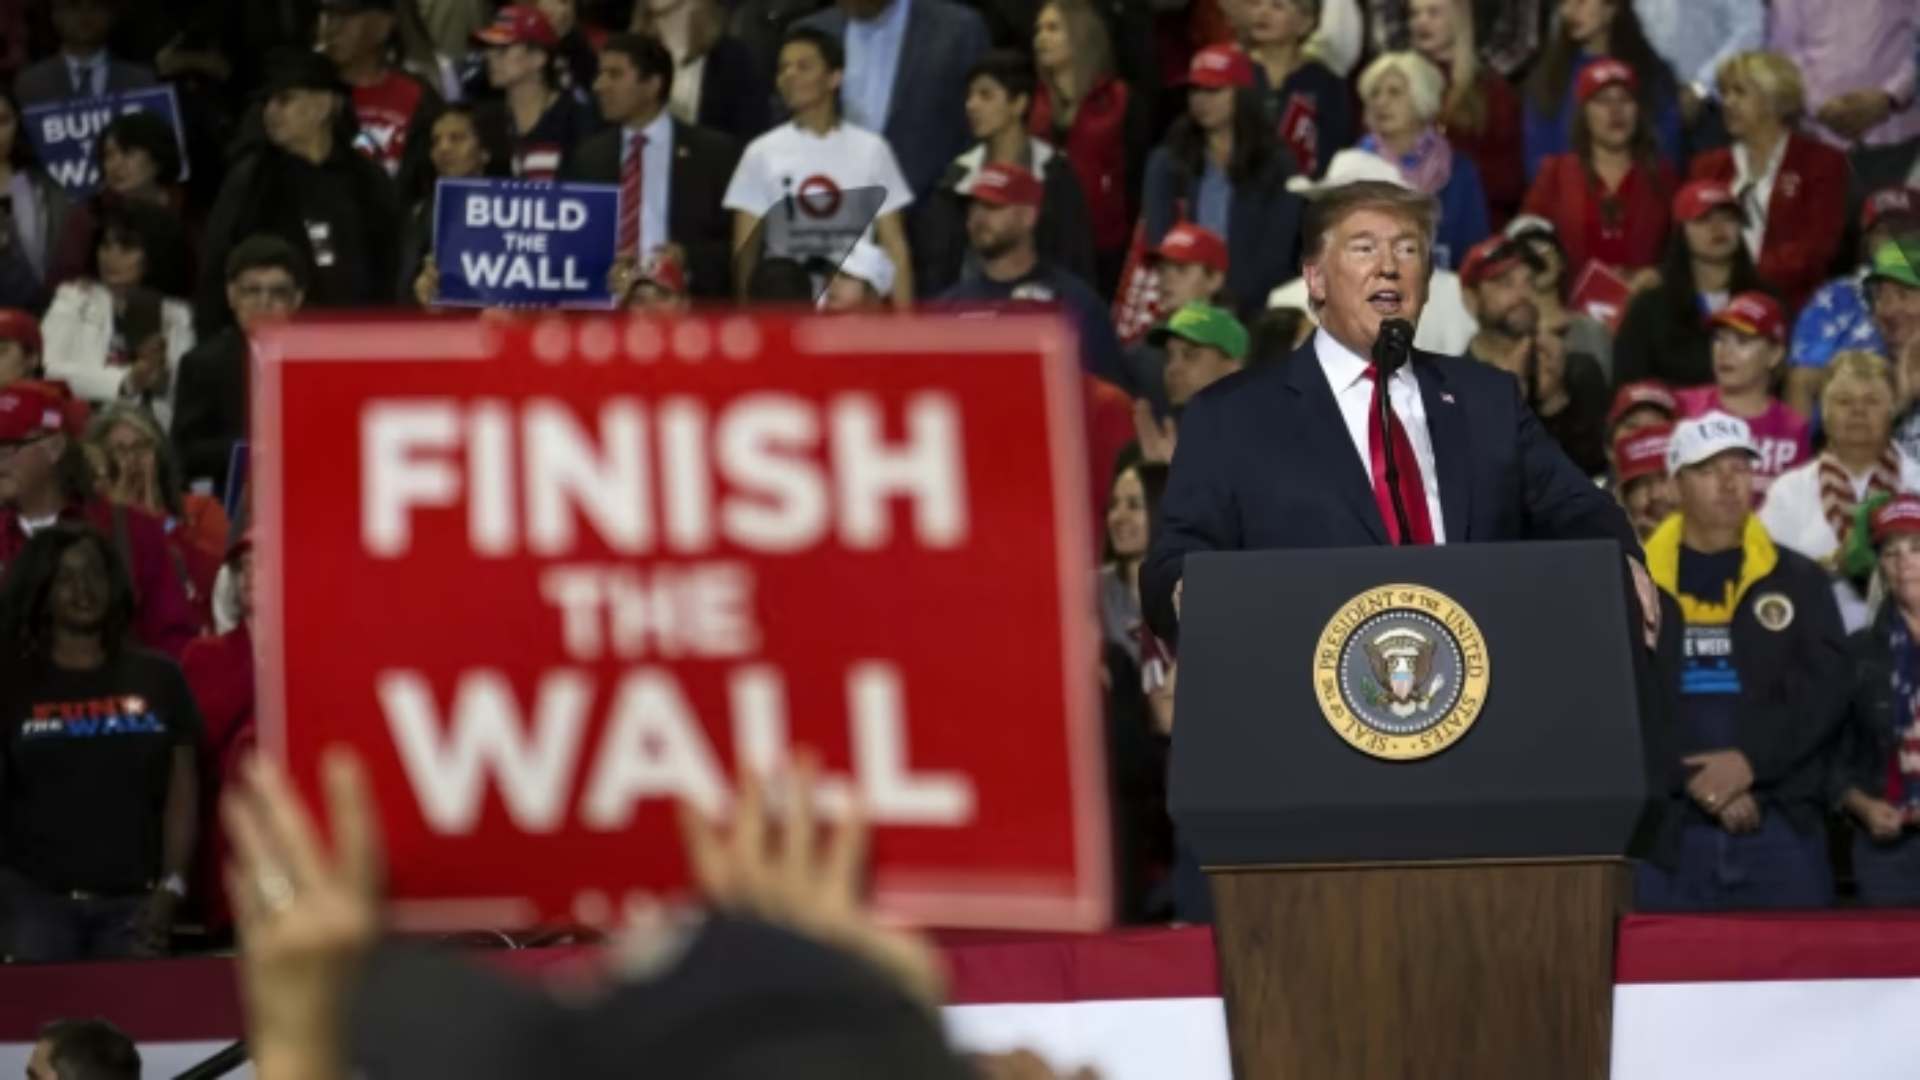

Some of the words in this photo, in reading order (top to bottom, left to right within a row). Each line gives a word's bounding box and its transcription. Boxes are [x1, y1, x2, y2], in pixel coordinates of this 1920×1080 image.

[466, 194, 588, 231] BUILD
[502, 232, 548, 252] THE
[460, 251, 589, 290] WALL
[1697, 420, 1742, 440] USA
[359, 391, 971, 558] FINISH
[539, 561, 763, 660] THE
[1400, 591, 1414, 603] OF
[1420, 594, 1440, 610] THE
[1320, 592, 1394, 669] PRESIDENT
[1445, 609, 1483, 678] UNITED
[1321, 678, 1334, 701] THE
[1330, 705, 1345, 718] OF
[1420, 694, 1477, 748] STATES
[375, 660, 979, 836] WALL
[1344, 719, 1389, 751] SEAL
